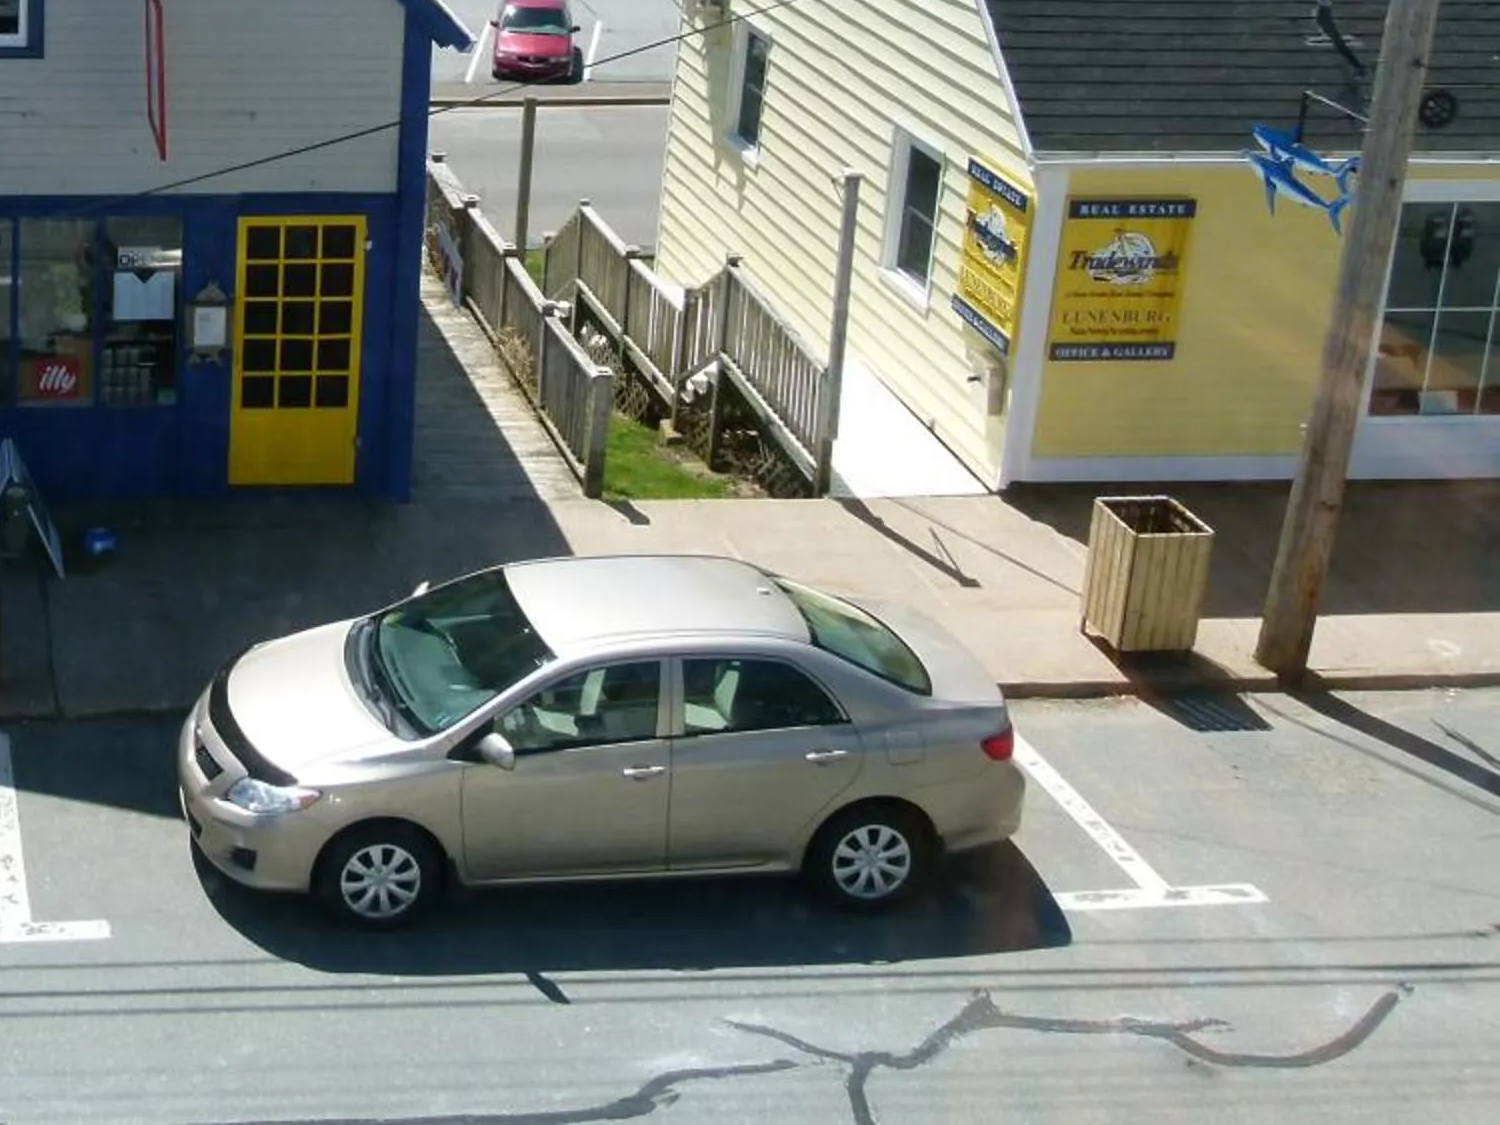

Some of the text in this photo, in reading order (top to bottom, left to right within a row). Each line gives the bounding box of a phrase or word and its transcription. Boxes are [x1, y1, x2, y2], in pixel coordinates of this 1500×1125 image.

[1080, 203, 1187, 215] REAL ESTATE
[1061, 309, 1172, 325] LUNENBURG
[1055, 346, 1099, 358] OFFICE
[1113, 346, 1169, 358] GALLERY
[39, 365, 77, 396] illy
